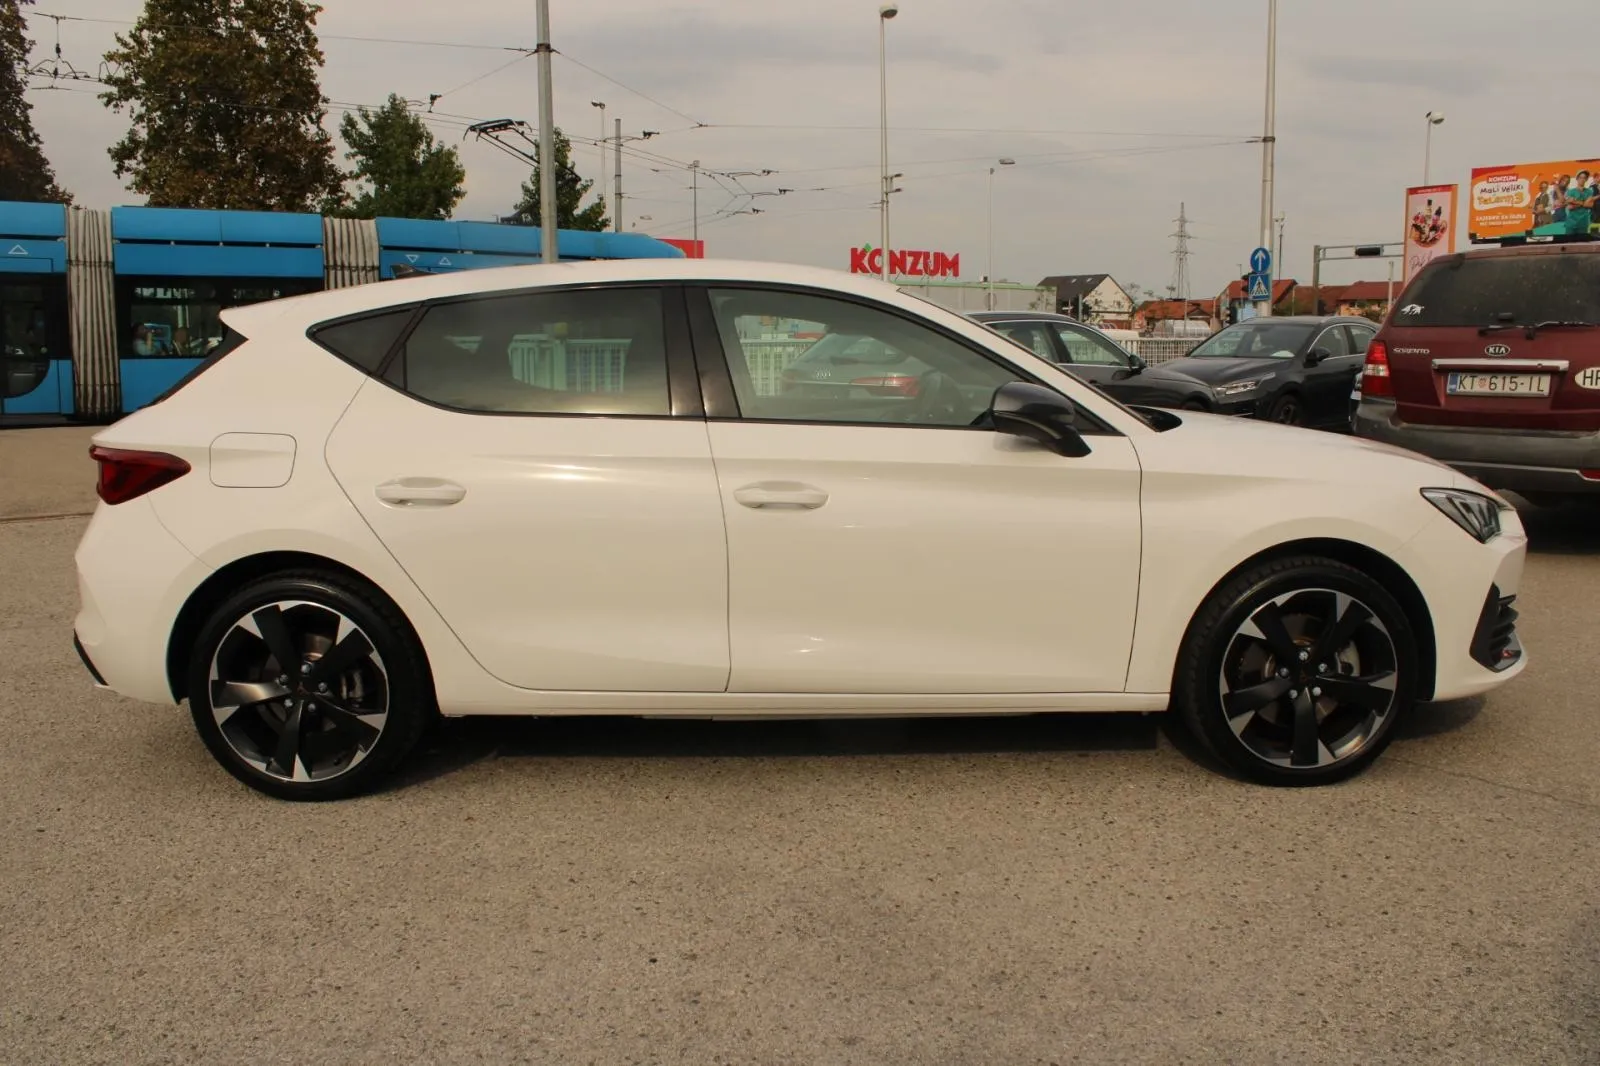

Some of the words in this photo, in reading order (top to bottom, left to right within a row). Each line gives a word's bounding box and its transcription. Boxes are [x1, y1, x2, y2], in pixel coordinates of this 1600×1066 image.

[1488, 175, 1517, 183] KONZUM
[850, 247, 960, 277] KONZUM
[1393, 347, 1430, 355] SORENTO
[1488, 346, 1506, 354] KIA
[1458, 374, 1478, 391] KT
[1488, 375, 1545, 393] 615-IL
